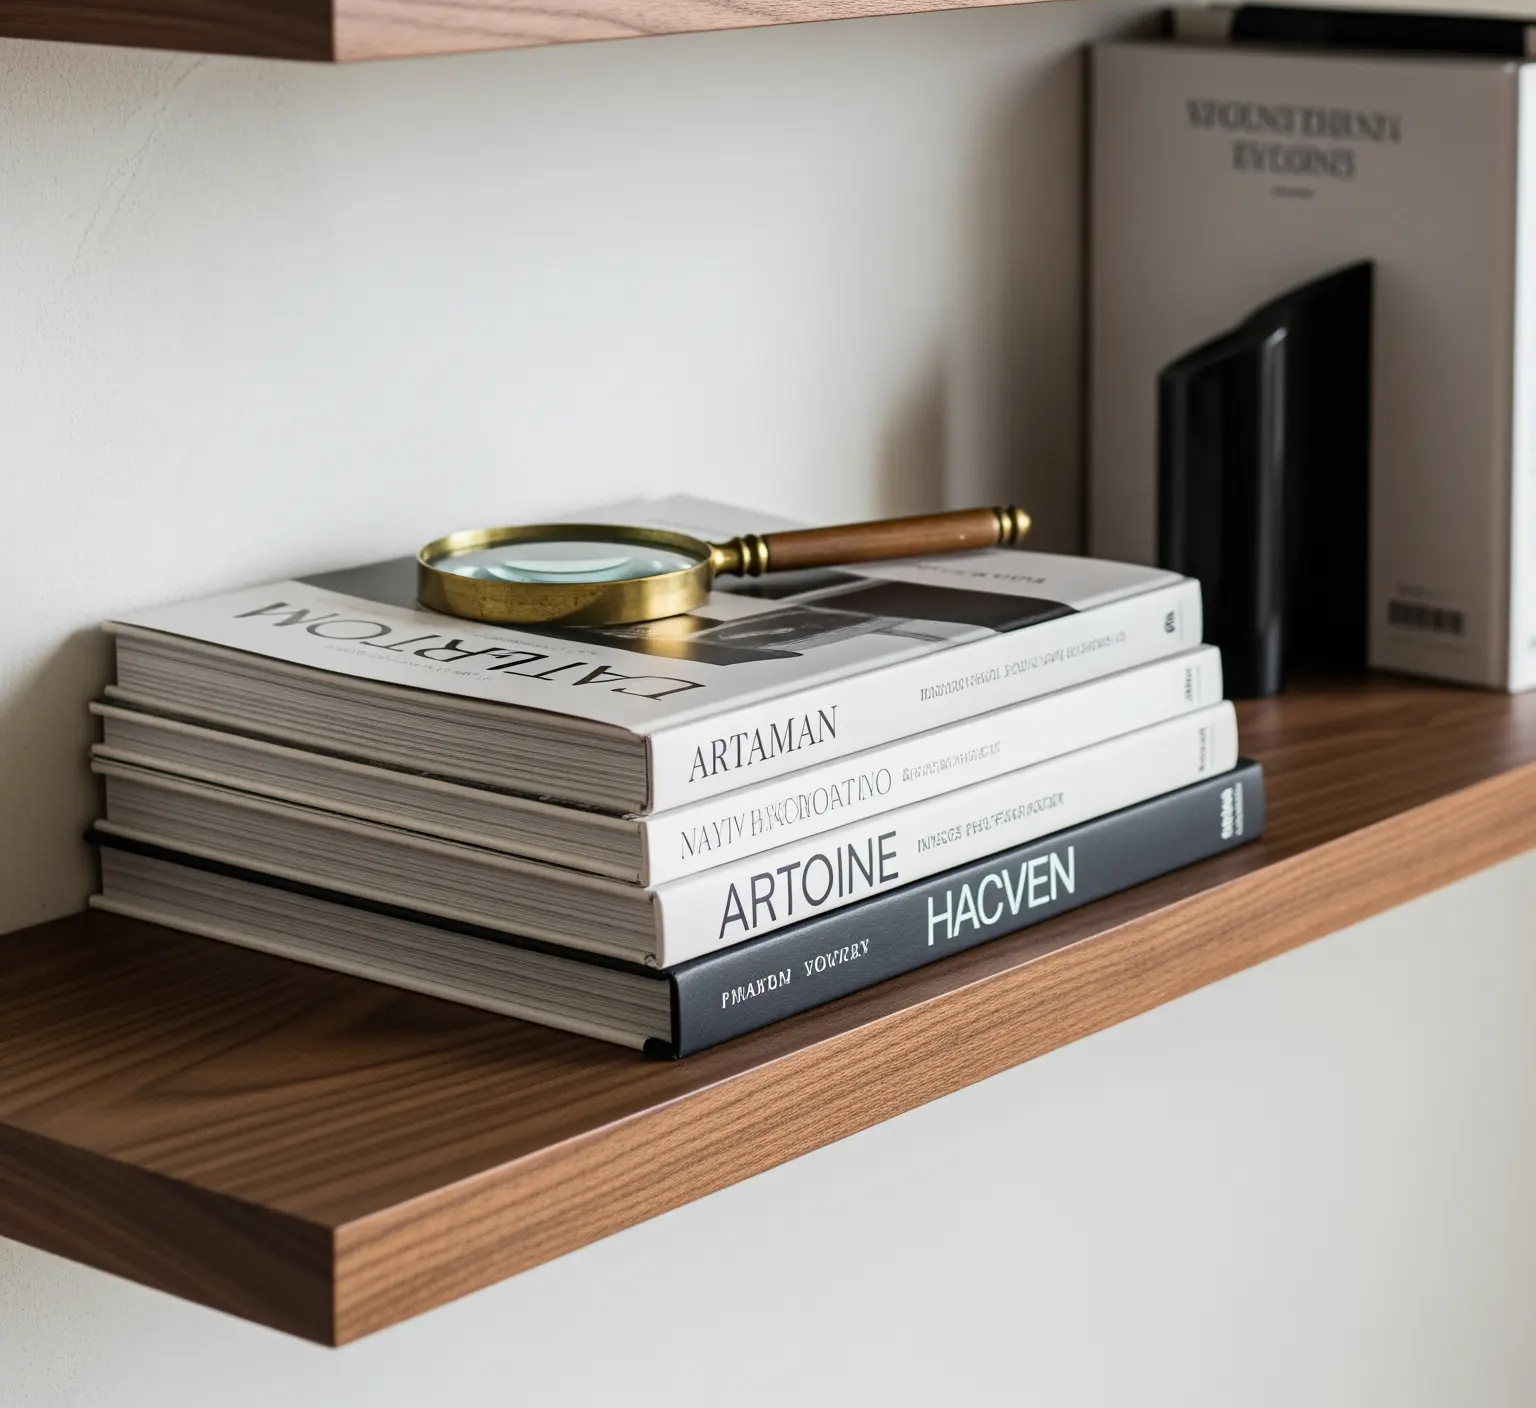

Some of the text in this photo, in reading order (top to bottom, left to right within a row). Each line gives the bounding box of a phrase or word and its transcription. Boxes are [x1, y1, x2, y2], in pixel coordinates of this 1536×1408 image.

[688, 705, 838, 783] ARTAMAN
[718, 830, 899, 940] ARTOINE
[927, 845, 1076, 946] HACVEN
